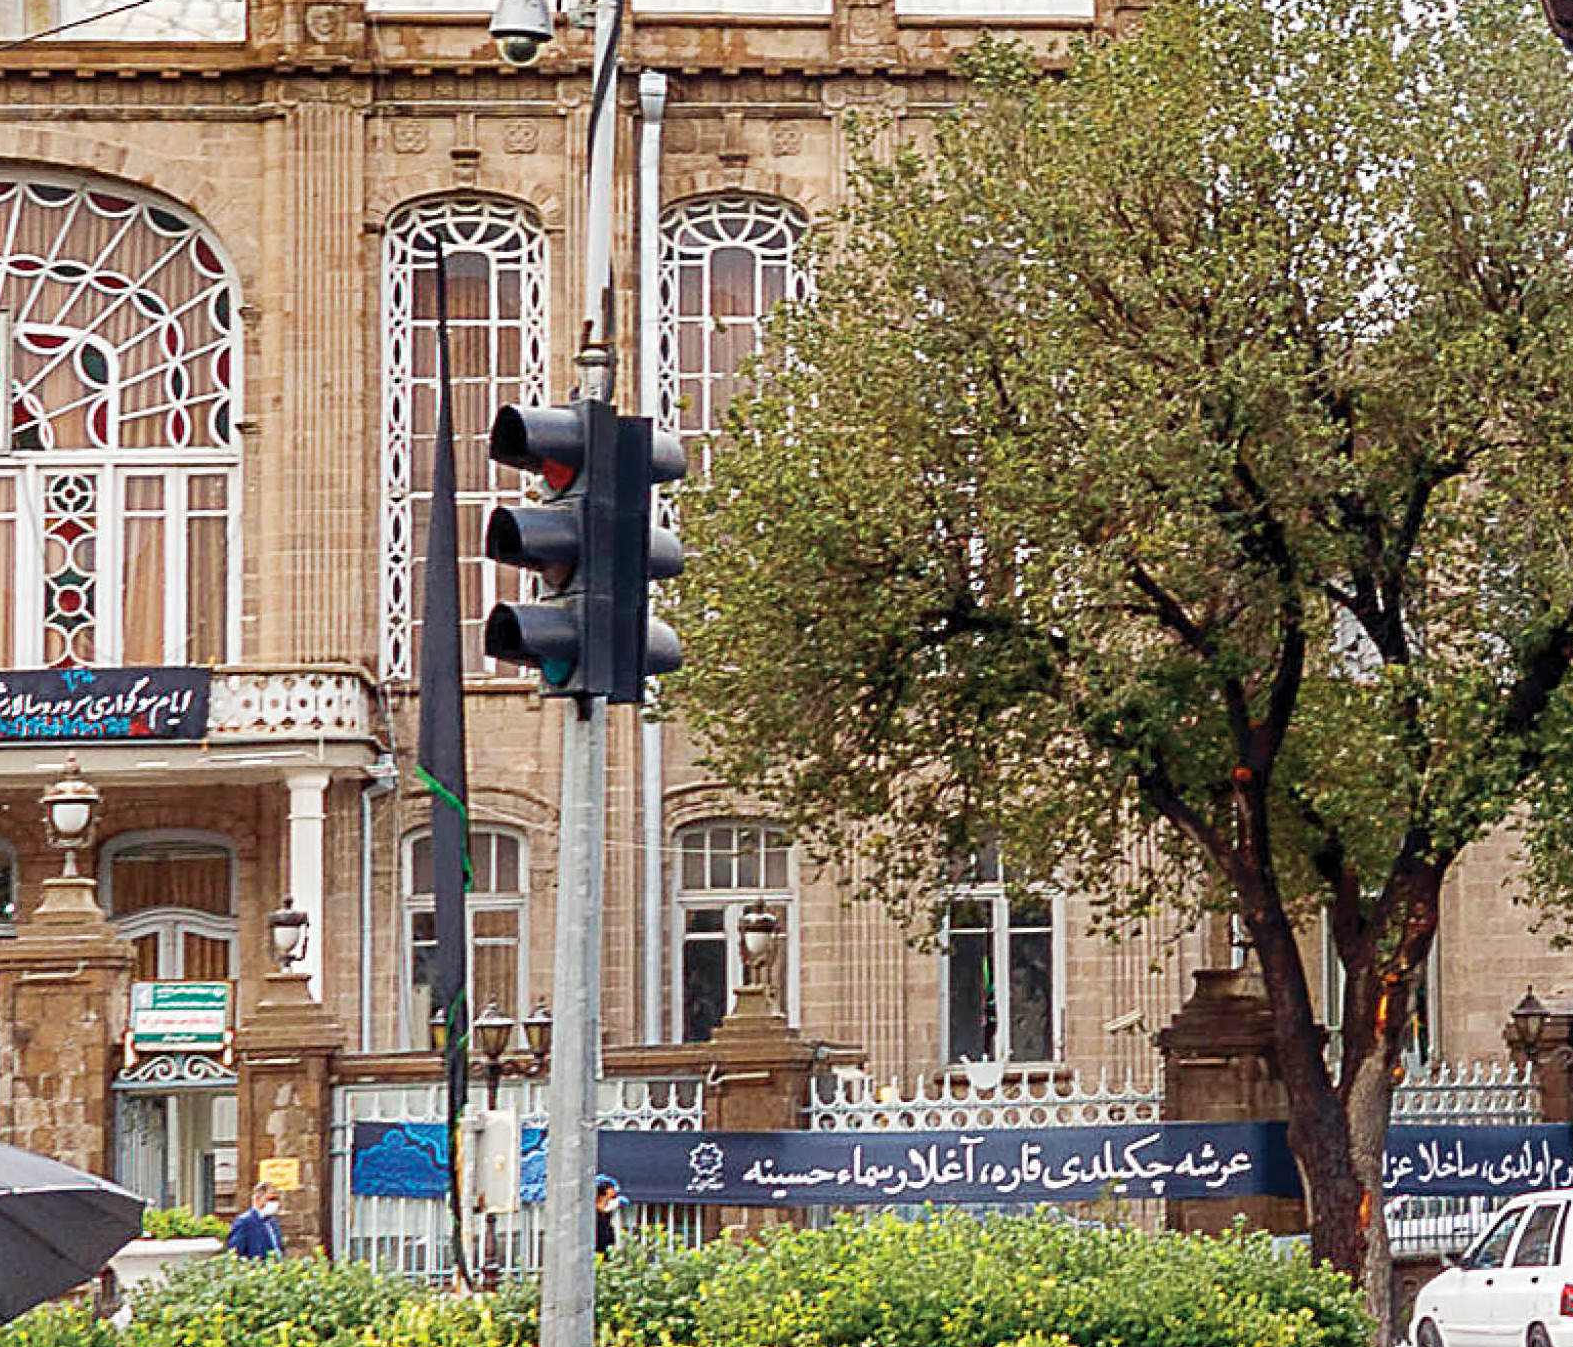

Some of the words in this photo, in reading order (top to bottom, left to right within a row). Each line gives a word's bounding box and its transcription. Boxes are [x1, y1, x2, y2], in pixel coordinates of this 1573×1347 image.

[148, 689, 193, 730] ایام
[742, 1157, 836, 1199] حسینه
[882, 1136, 986, 1194] آغلار
[1042, 1132, 1173, 1195] چکیلدی
[1174, 1142, 1252, 1187] عرشه
[1418, 1139, 1478, 1183] ساخلا
